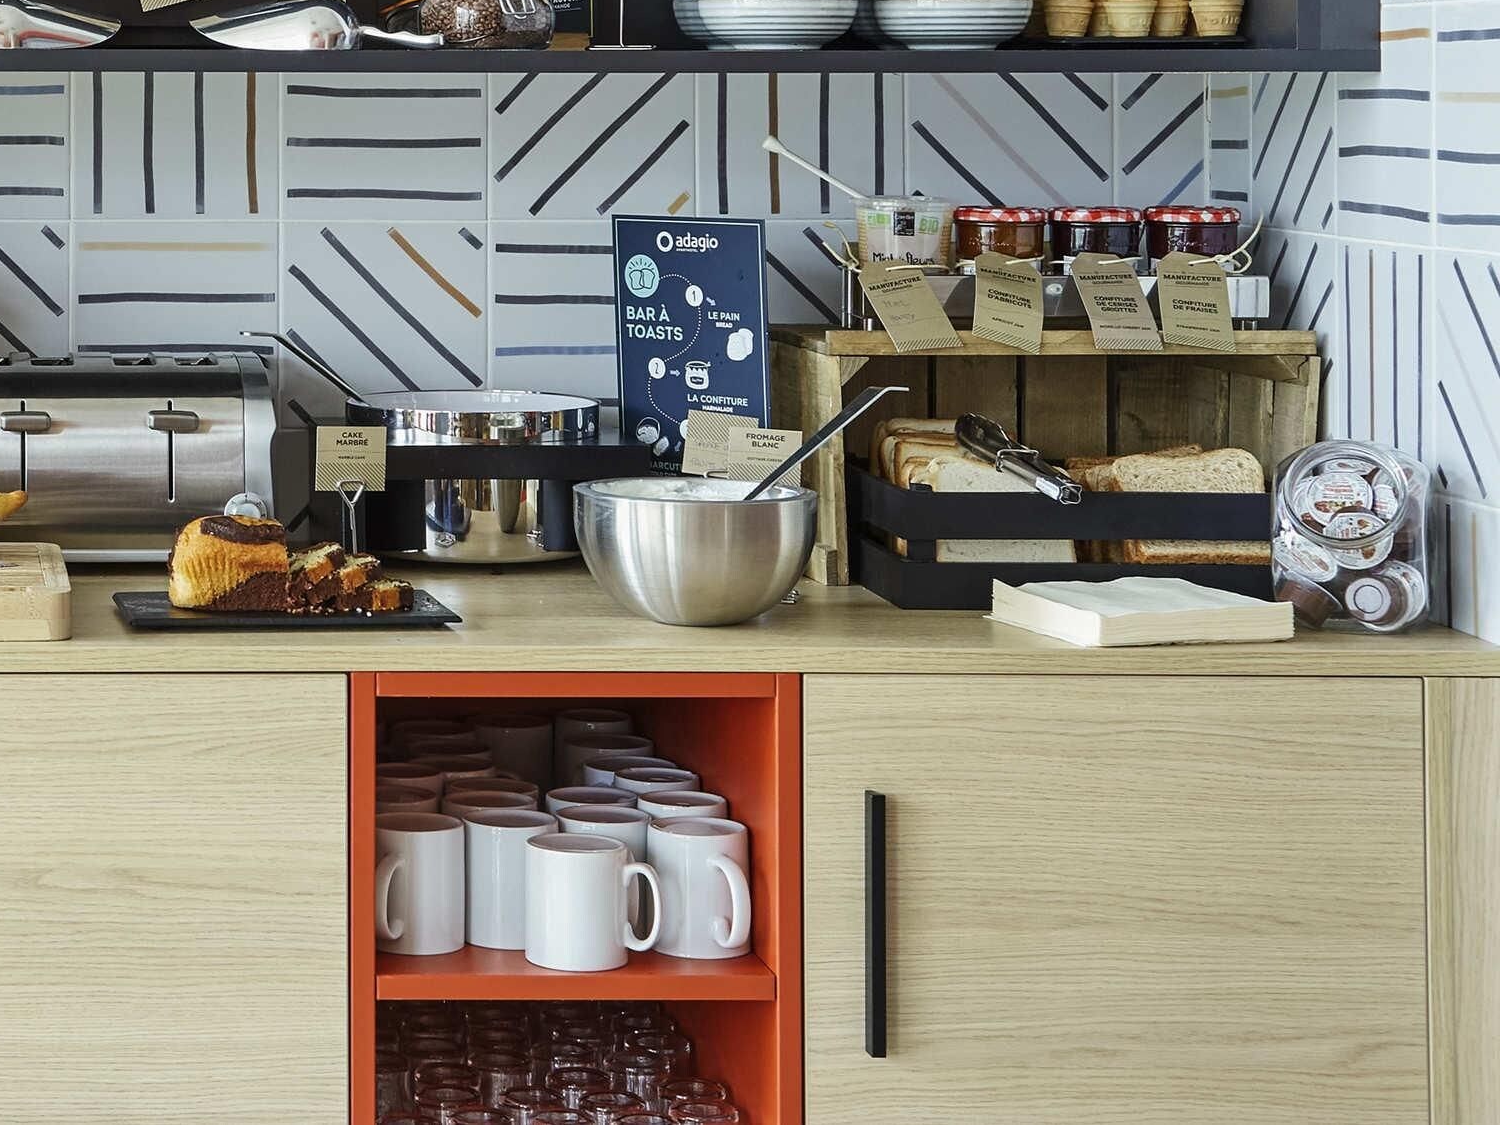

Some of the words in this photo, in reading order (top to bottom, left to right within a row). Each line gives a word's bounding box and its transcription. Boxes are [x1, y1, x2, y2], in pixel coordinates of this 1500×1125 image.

[918, 218, 940, 235] BIO
[675, 231, 719, 252] adagio
[980, 268, 1037, 283] MANUFACTURE
[1163, 274, 1222, 282] MANUFACTURE
[868, 276, 922, 291] MANUFACTURE
[987, 288, 1032, 303] CONFITURE
[987, 294, 1032, 309] D'ABRICOTS
[1172, 298, 1218, 308] CONFITURE
[1185, 305, 1219, 314] FRAISES
[626, 305, 656, 321] BAR
[658, 303, 670, 322] À
[707, 311, 719, 320] LE
[720, 312, 740, 321] PAIN
[626, 324, 684, 341] TOASTS
[687, 393, 699, 402] LA
[700, 394, 749, 407] CONFITURE
[336, 438, 369, 446] MARBRÉ
[746, 432, 785, 442] FROMAGE
[752, 441, 780, 449] BLANC
